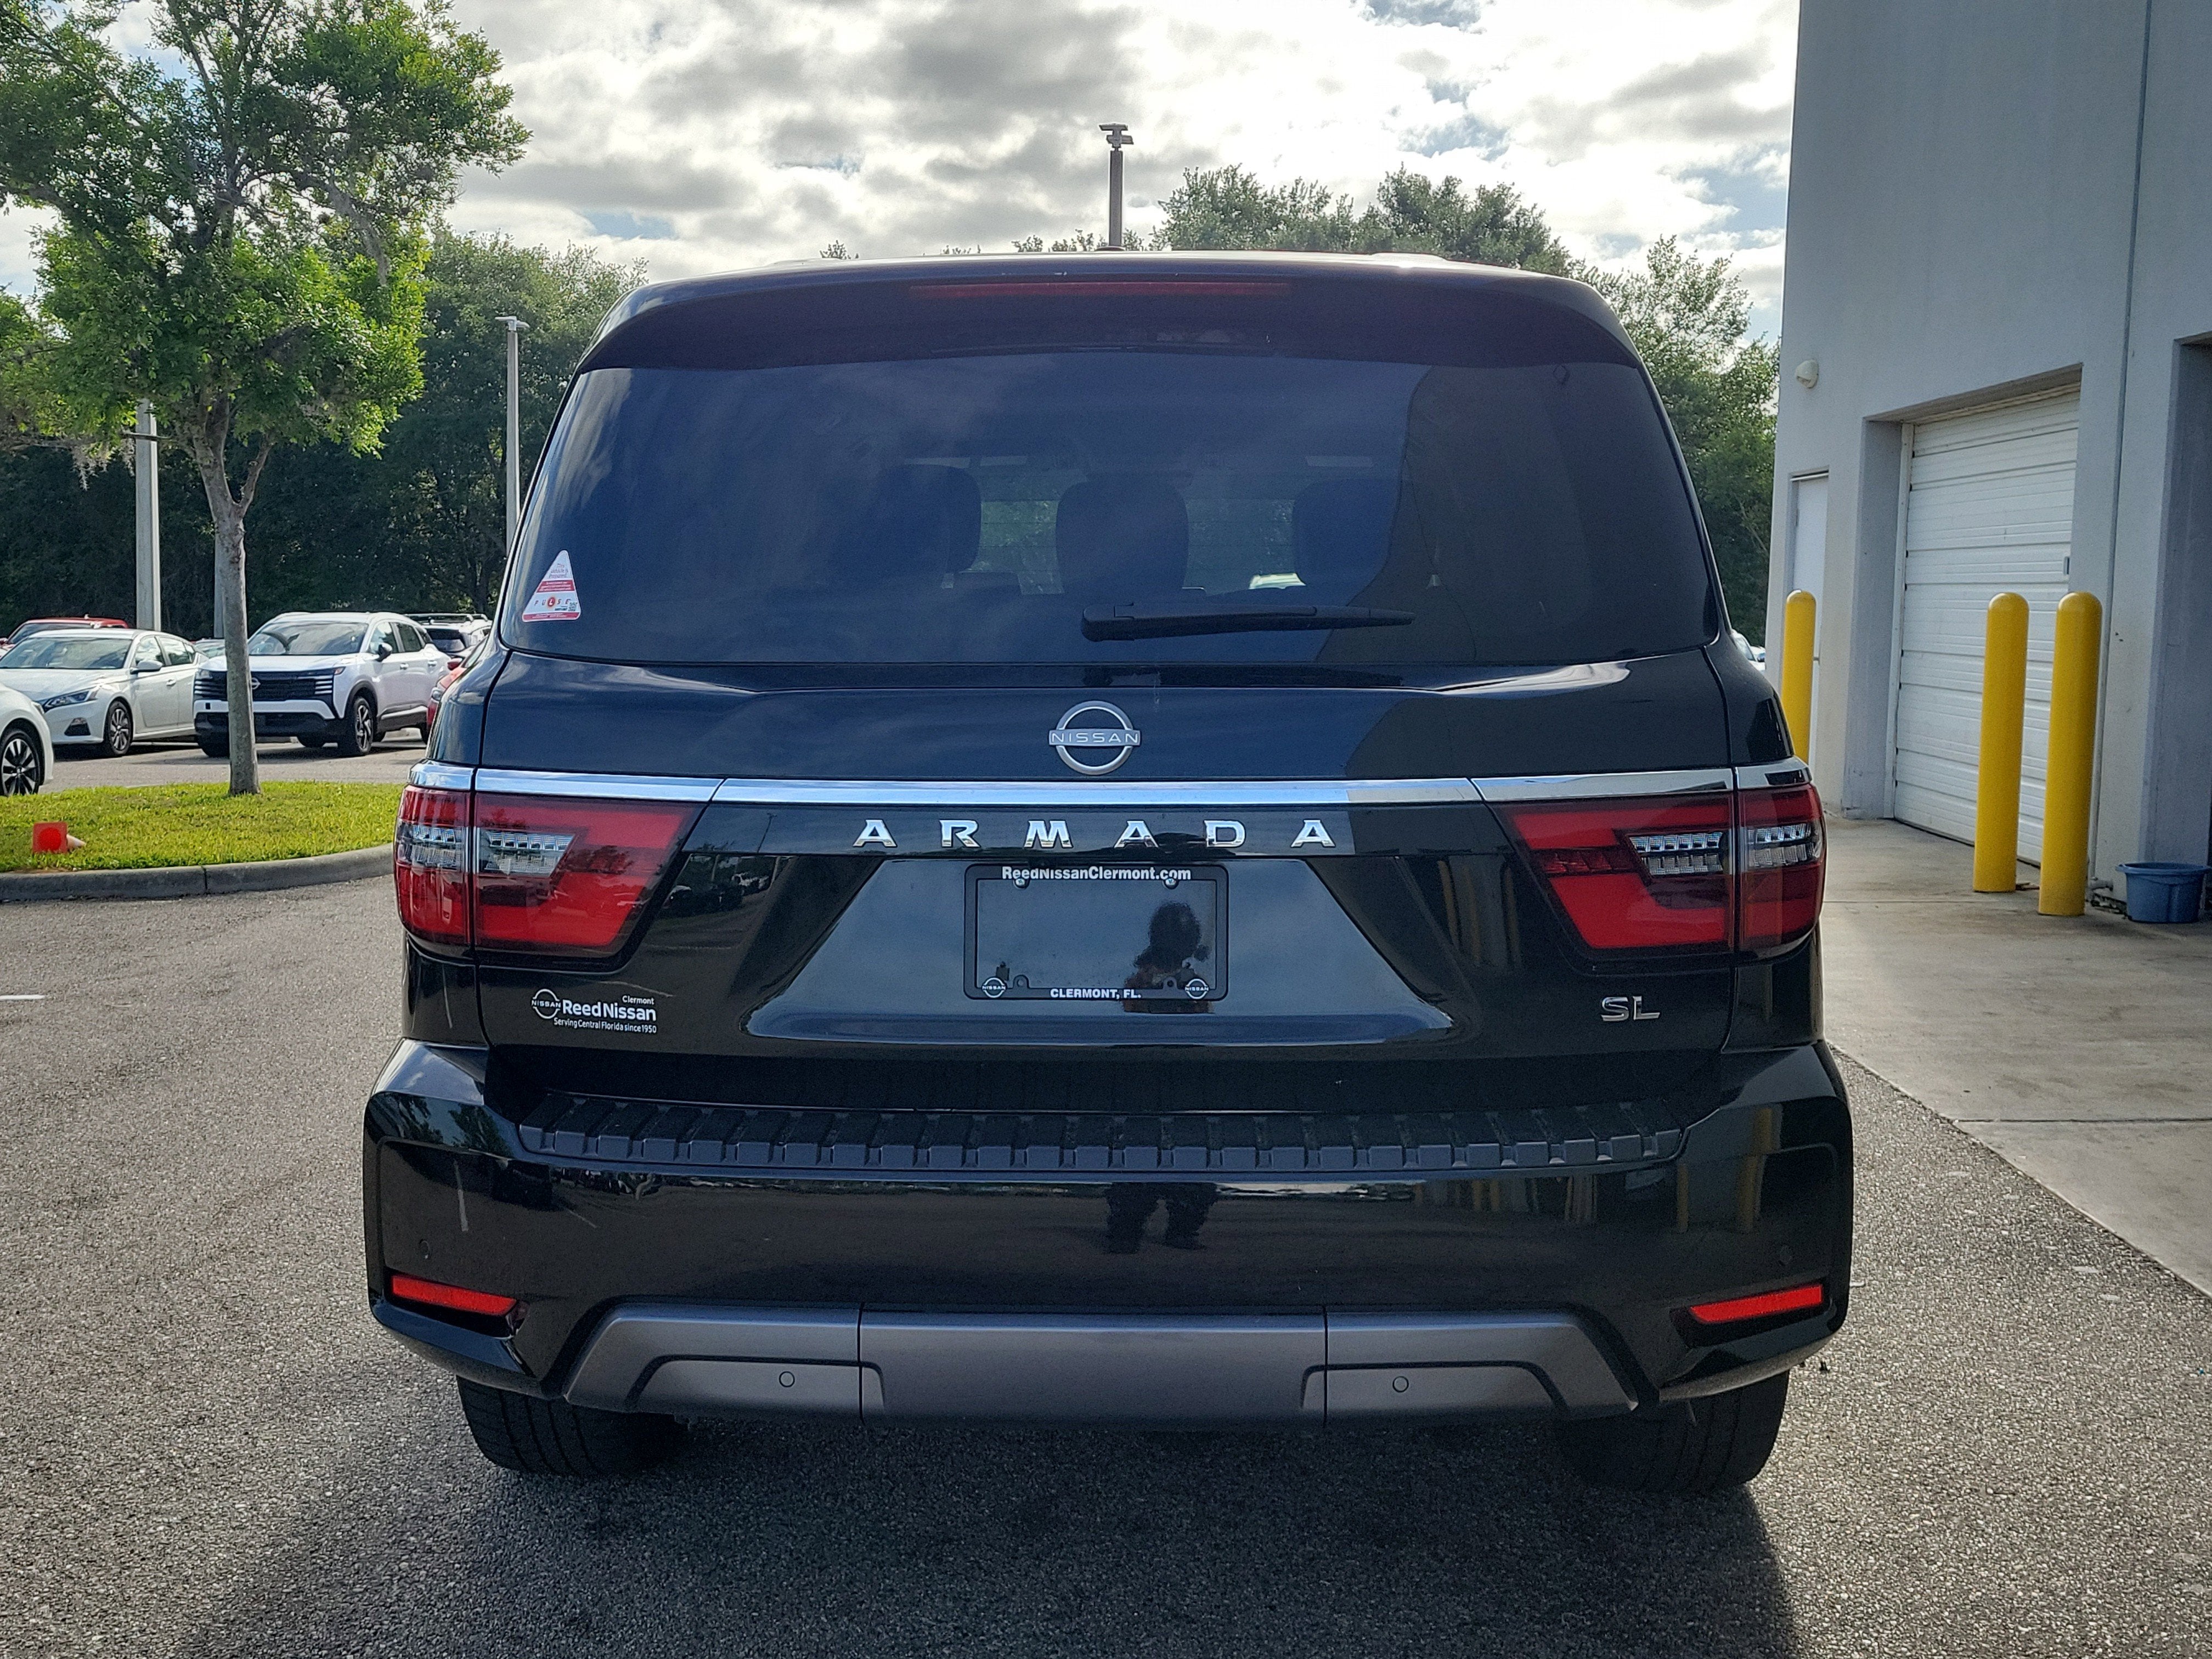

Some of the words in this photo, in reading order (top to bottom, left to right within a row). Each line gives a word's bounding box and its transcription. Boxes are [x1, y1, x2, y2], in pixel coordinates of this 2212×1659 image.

[1051, 732, 1138, 743] NISSAN
[853, 819, 1335, 848] ARMADA
[1002, 866, 1191, 880] ReedNissanClermont.com
[622, 995, 654, 1005] Clermont
[1050, 988, 1120, 1000] CLERMONT,
[1123, 989, 1142, 998] FL.
[532, 1000, 561, 1008] NISSAN
[562, 999, 601, 1016] Reed
[603, 1002, 657, 1022] Nissan
[1601, 996, 1661, 1022] SL
[554, 1017, 578, 1029] Serving
[578, 1019, 601, 1029] Central
[601, 1021, 624, 1031] Florida
[624, 1023, 641, 1032] since
[641, 1024, 657, 1034] 1950
